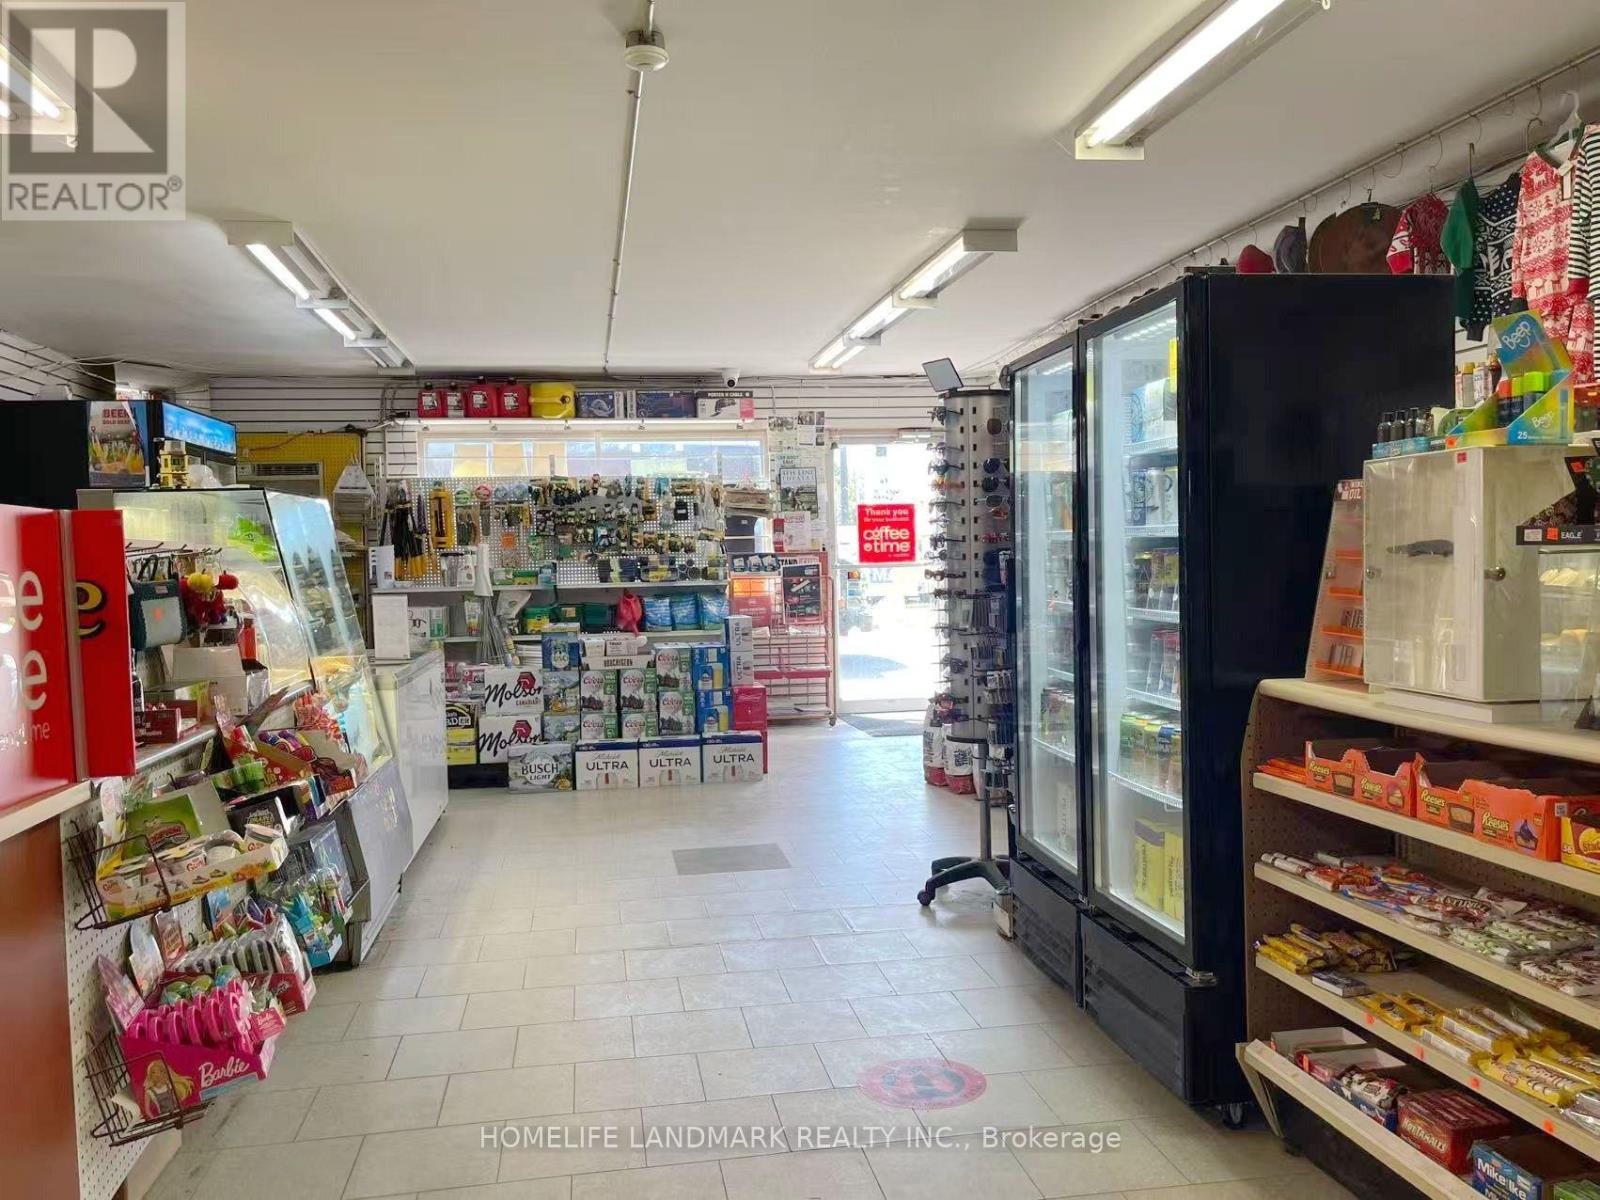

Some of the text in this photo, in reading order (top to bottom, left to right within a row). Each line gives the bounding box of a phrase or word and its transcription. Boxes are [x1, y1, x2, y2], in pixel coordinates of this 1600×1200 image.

[1502, 321, 1531, 349] Beep
[865, 508, 909, 519] Thank you
[863, 526, 910, 540] coffee
[1561, 531, 1583, 539] EAGLE
[874, 540, 911, 553] time
[649, 758, 691, 767] ULTRA
[713, 754, 754, 763] ULTRA
[521, 763, 558, 775] BUSCH
[586, 761, 628, 771] ULTRA
[198, 1057, 250, 1087] Barbie
[1477, 1157, 1527, 1200] Mike Ike
